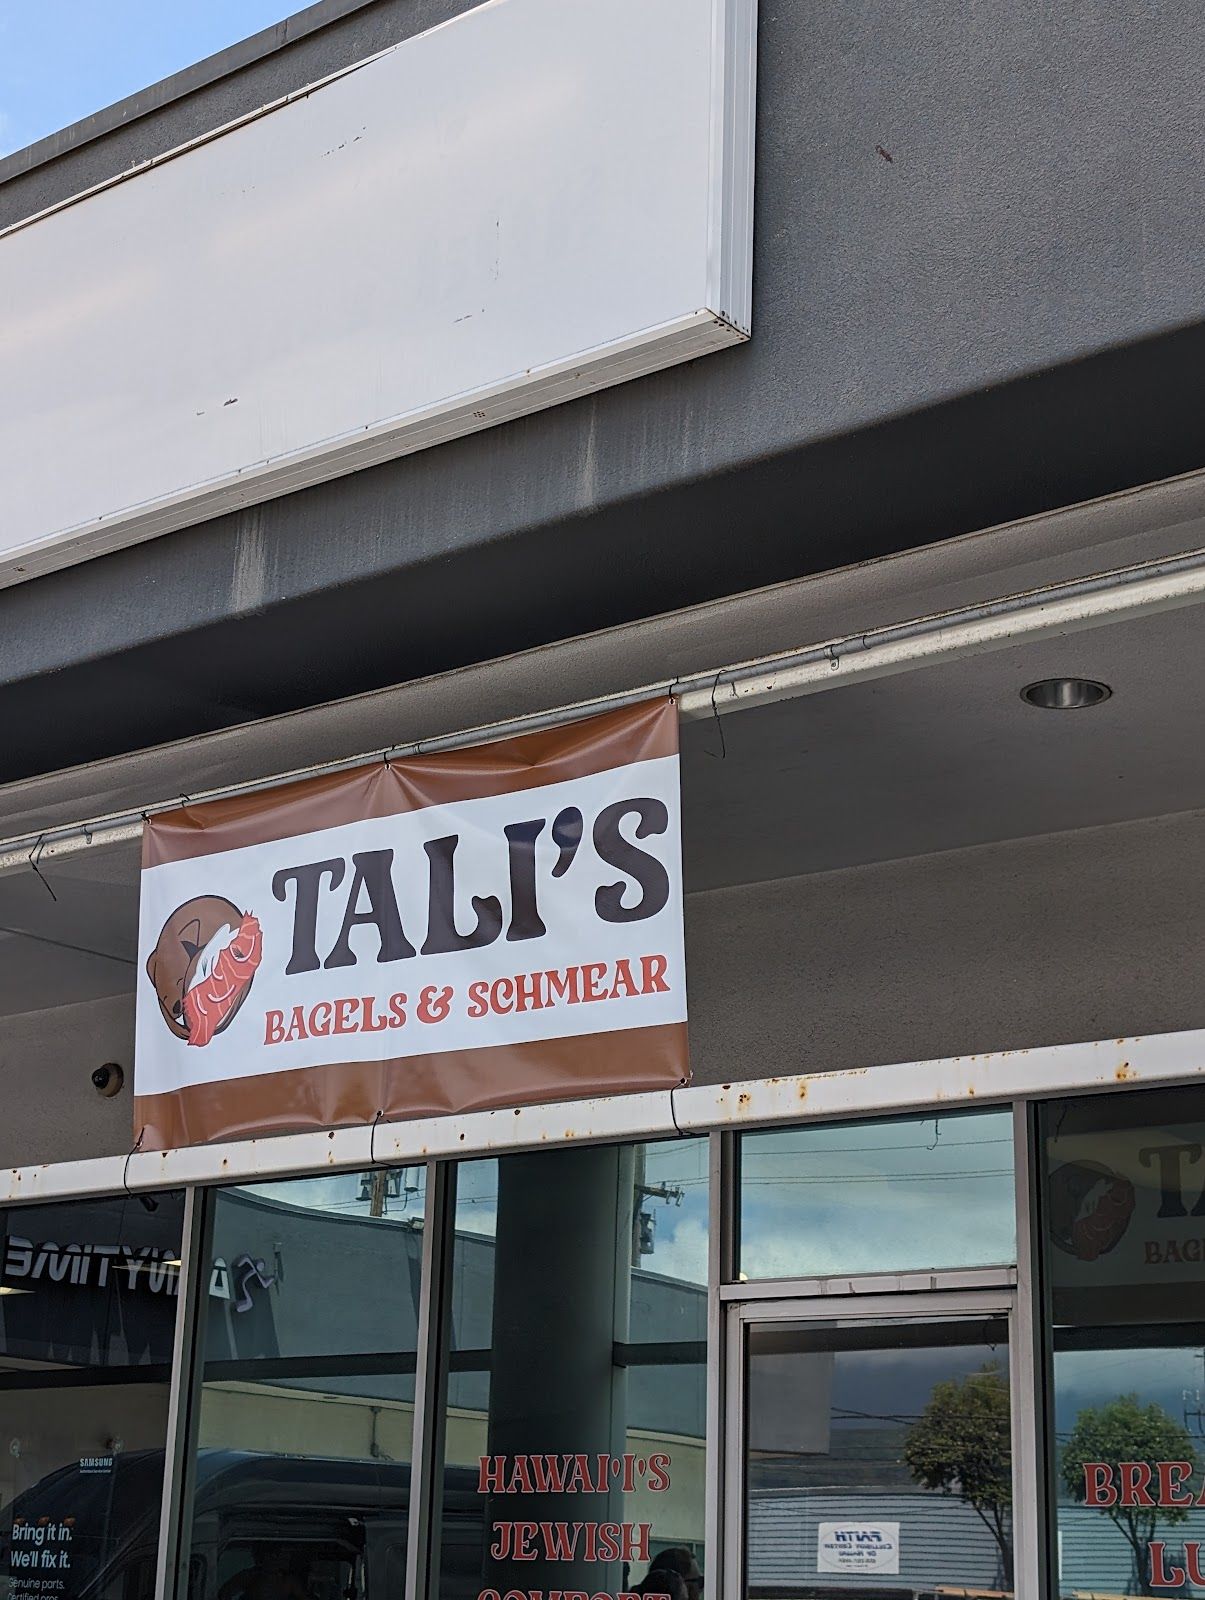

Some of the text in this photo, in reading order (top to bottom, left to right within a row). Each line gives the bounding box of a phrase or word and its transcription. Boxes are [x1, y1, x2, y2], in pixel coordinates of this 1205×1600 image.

[271, 797, 670, 975] TALI'S
[263, 953, 670, 1046] BAGELS & SCHMEAR
[1138, 1143, 1205, 1218] T
[1143, 1238, 1205, 1265] BAG
[79, 1457, 113, 1467] SAMSUNG
[477, 1453, 671, 1493] HAWAI'I'S
[1082, 1461, 1205, 1507] BRE
[12, 1522, 73, 1546] Bring it in.
[490, 1521, 651, 1561] JEWISH
[10, 1550, 71, 1568] We'll fix it.
[8, 1577, 65, 1591] Genuine parts.
